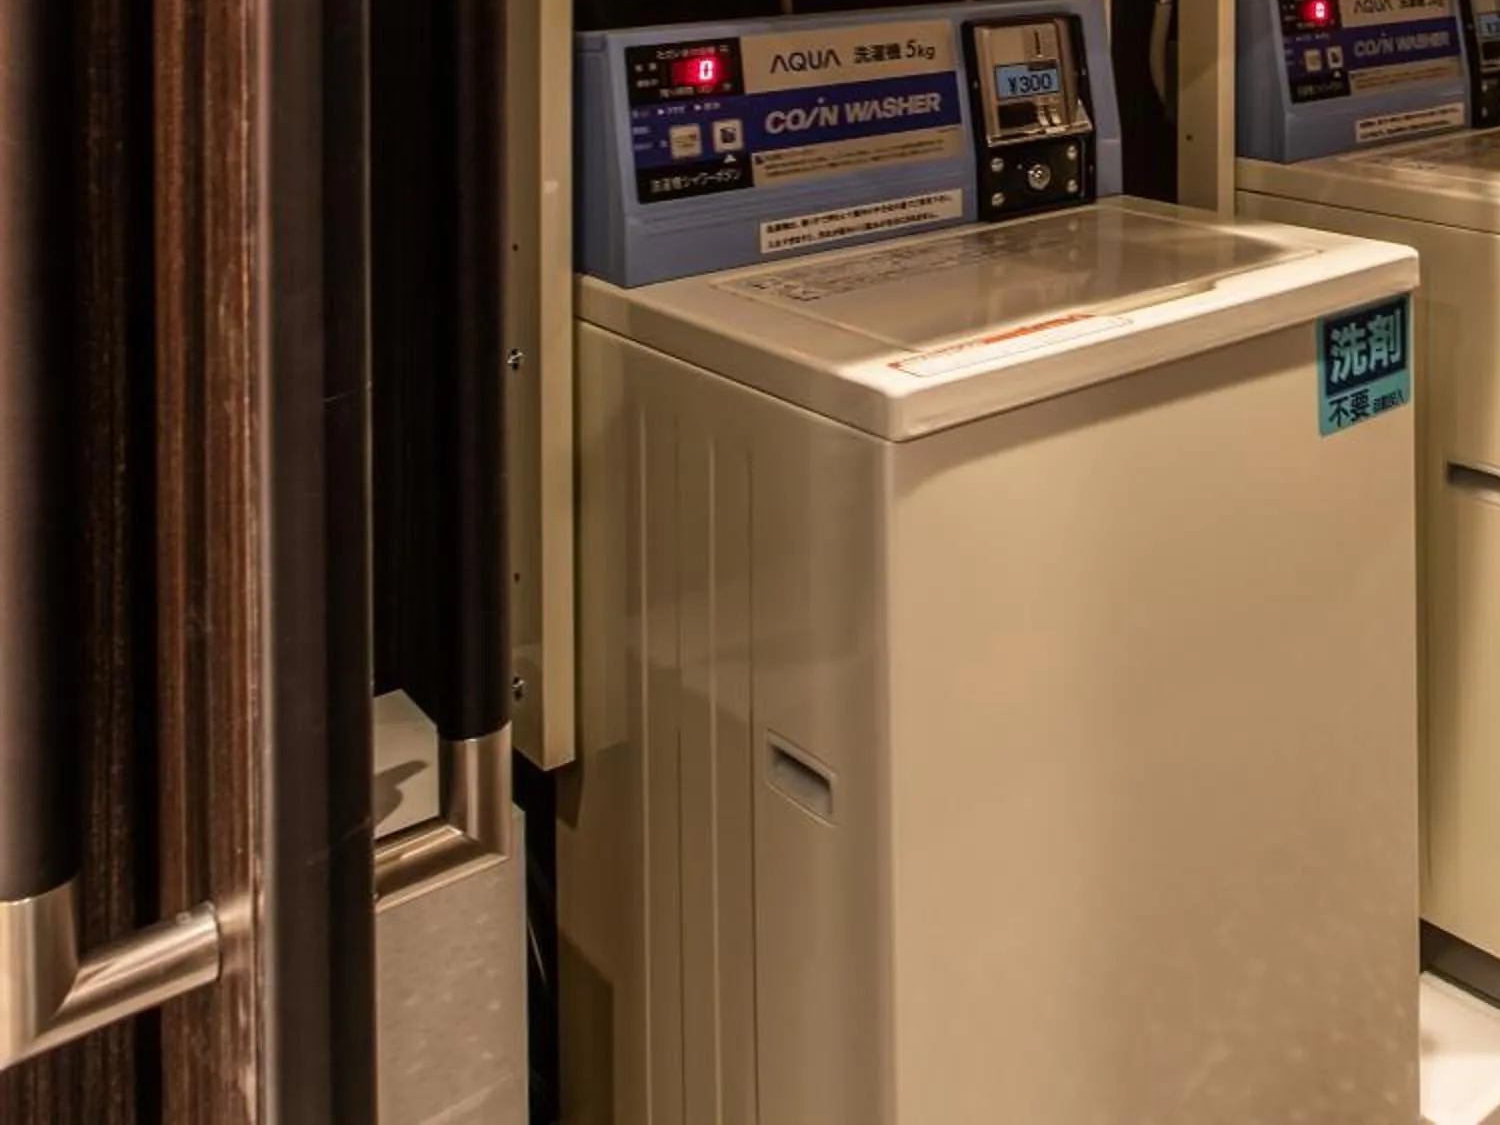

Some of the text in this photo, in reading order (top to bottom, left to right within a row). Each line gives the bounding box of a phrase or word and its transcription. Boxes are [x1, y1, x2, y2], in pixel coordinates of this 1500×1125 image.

[699, 59, 714, 81] 0
[769, 48, 843, 74] AQUA
[905, 39, 936, 61] 5kg
[844, 91, 942, 124] WASHER
[1330, 308, 1402, 384] 洗剤
[1328, 388, 1371, 428] 不要
